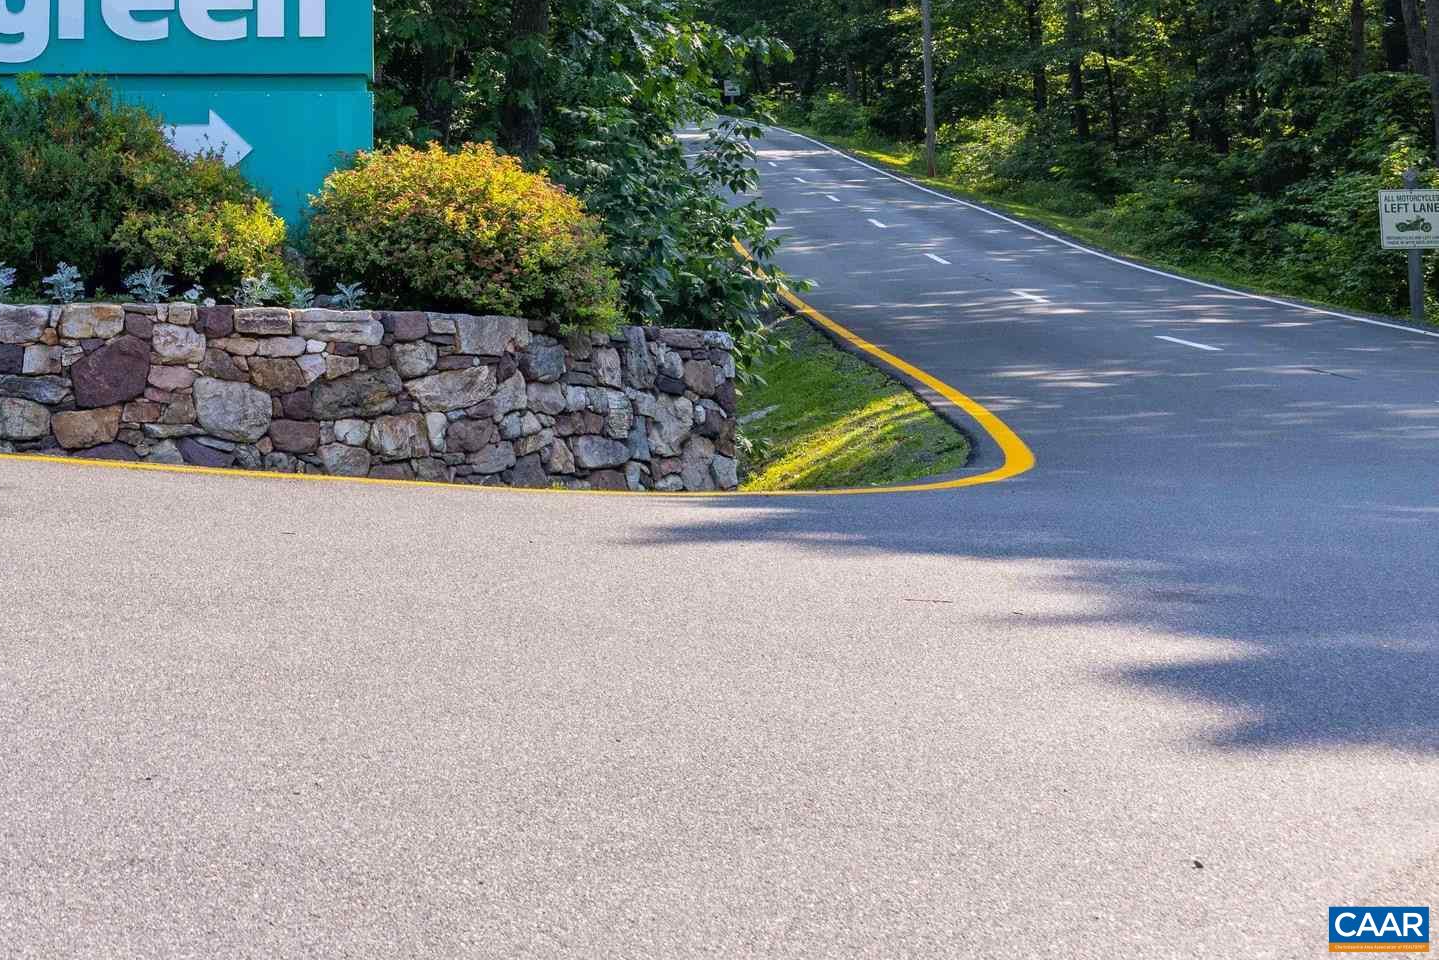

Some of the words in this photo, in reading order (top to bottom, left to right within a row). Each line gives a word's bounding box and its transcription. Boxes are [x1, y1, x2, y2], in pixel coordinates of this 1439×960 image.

[1384, 194, 1395, 202] ALL
[1384, 203, 1408, 213] LEFT
[1413, 203, 1439, 213] LANE
